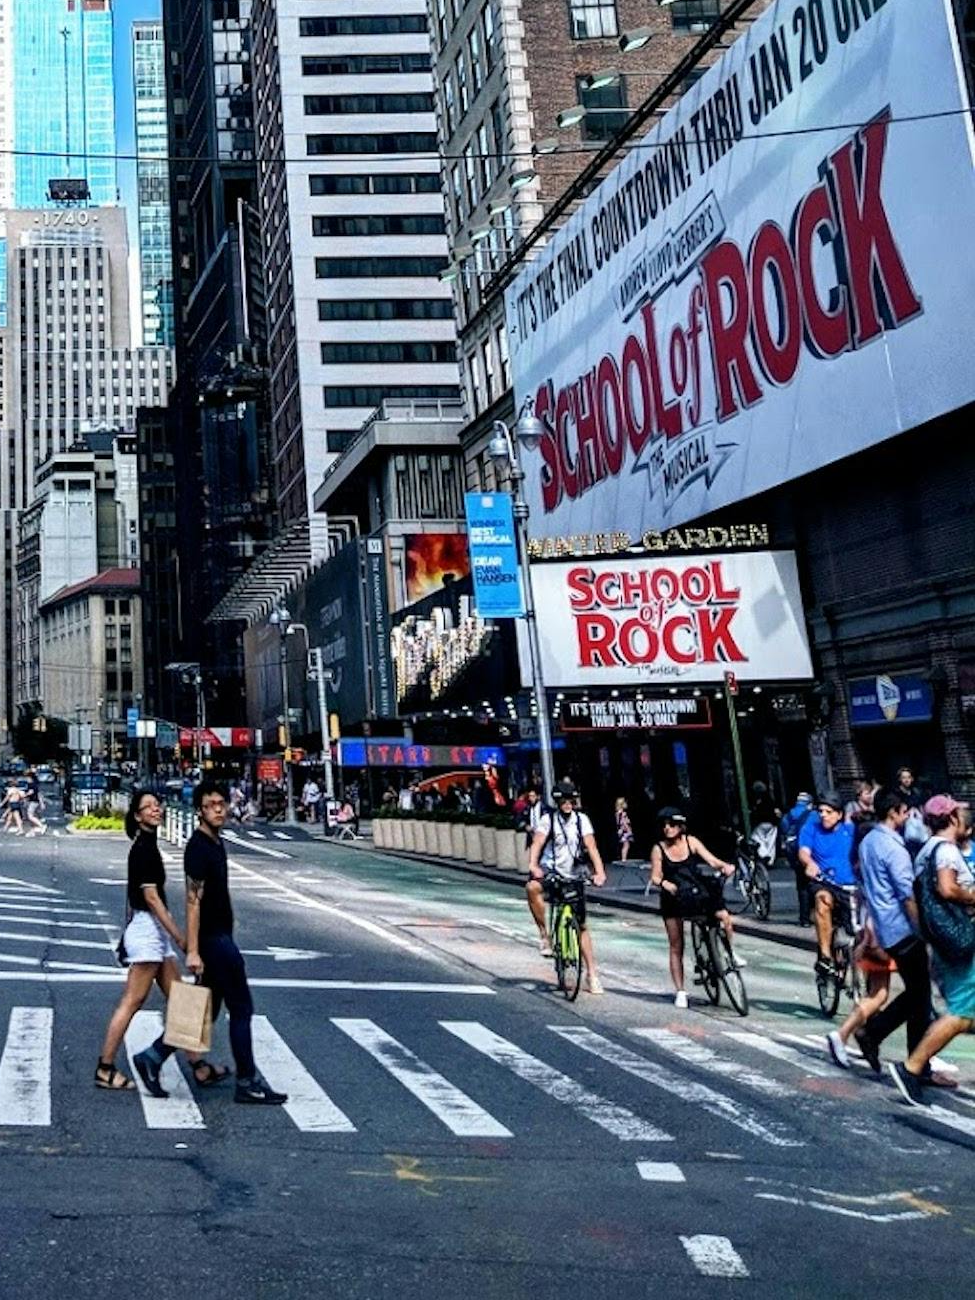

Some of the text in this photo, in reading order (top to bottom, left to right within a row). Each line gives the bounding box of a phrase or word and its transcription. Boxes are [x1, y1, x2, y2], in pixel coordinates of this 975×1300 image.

[517, 283, 537, 343] IT'S
[537, 260, 559, 323] THE
[557, 228, 593, 304] FINAL
[591, 126, 691, 270] COUNTDOWN!
[690, 73, 743, 176] THRU
[748, 26, 793, 125] JAN
[43, 210, 89, 226] 1740
[620, 204, 714, 311] ANDREW LLOYD WEBBER'S
[535, 104, 924, 513] SCHOOL of ROCK
[649, 438, 665, 471] THE
[663, 433, 710, 497] MUSICAL
[470, 527, 496, 536] BEST
[471, 534, 513, 544] MUSICAL
[527, 523, 770, 558] WINTER GARDEN
[475, 565, 501, 574] EVAN
[476, 573, 517, 584] HANSEN
[567, 560, 741, 611] SCHOOL
[639, 601, 666, 629] of
[574, 607, 749, 668] ROCK
[569, 699, 697, 716] IT'S THE FINAL COUNTDOWN!
[591, 712, 678, 728] THRU JAN. 20 ONLY
